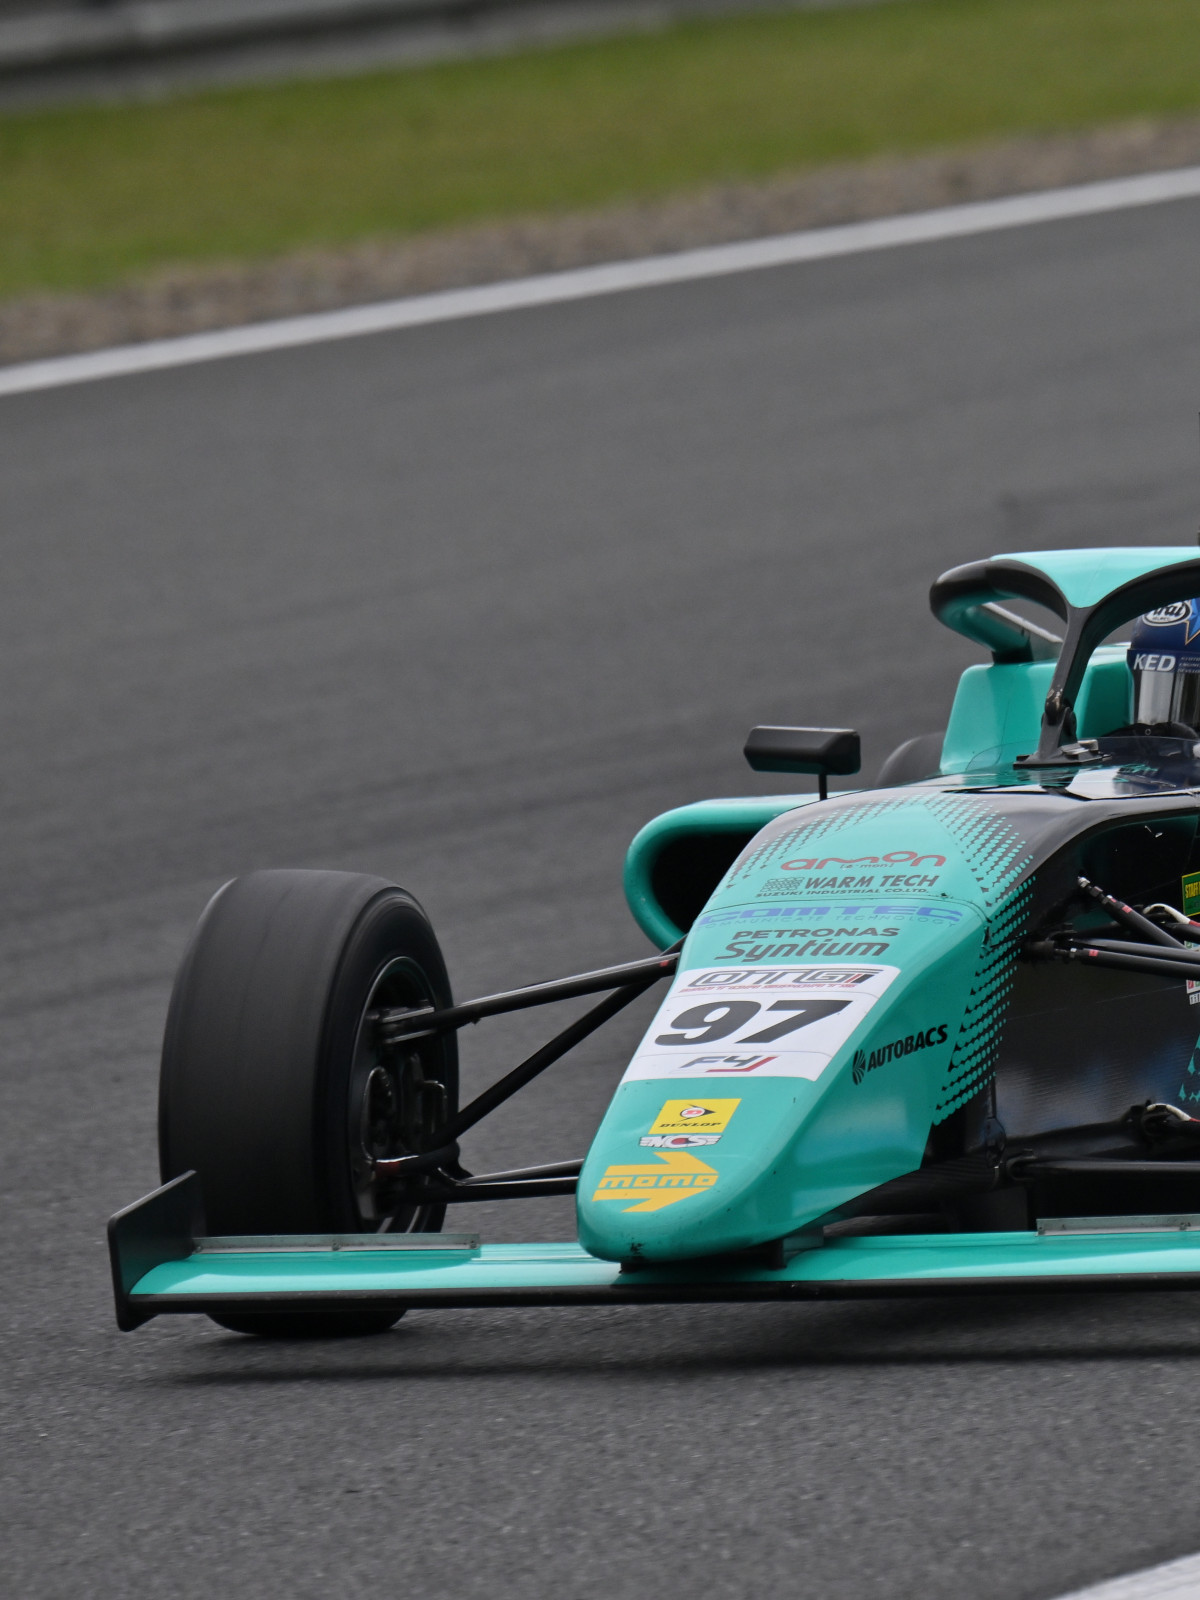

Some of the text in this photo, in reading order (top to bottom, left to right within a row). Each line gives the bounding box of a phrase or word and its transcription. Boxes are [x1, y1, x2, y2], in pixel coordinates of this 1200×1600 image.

[1133, 653, 1176, 672] KED
[780, 850, 947, 871] amon
[804, 875, 940, 890] WARM TECH
[756, 890, 803, 898] SUZUKI
[698, 905, 962, 926] COMTEC
[732, 928, 900, 940] PETRONAS
[714, 939, 890, 962] Syntium
[654, 1000, 854, 1046] 97
[867, 1023, 948, 1073] AUTOBACS
[598, 1174, 719, 1189] momo
